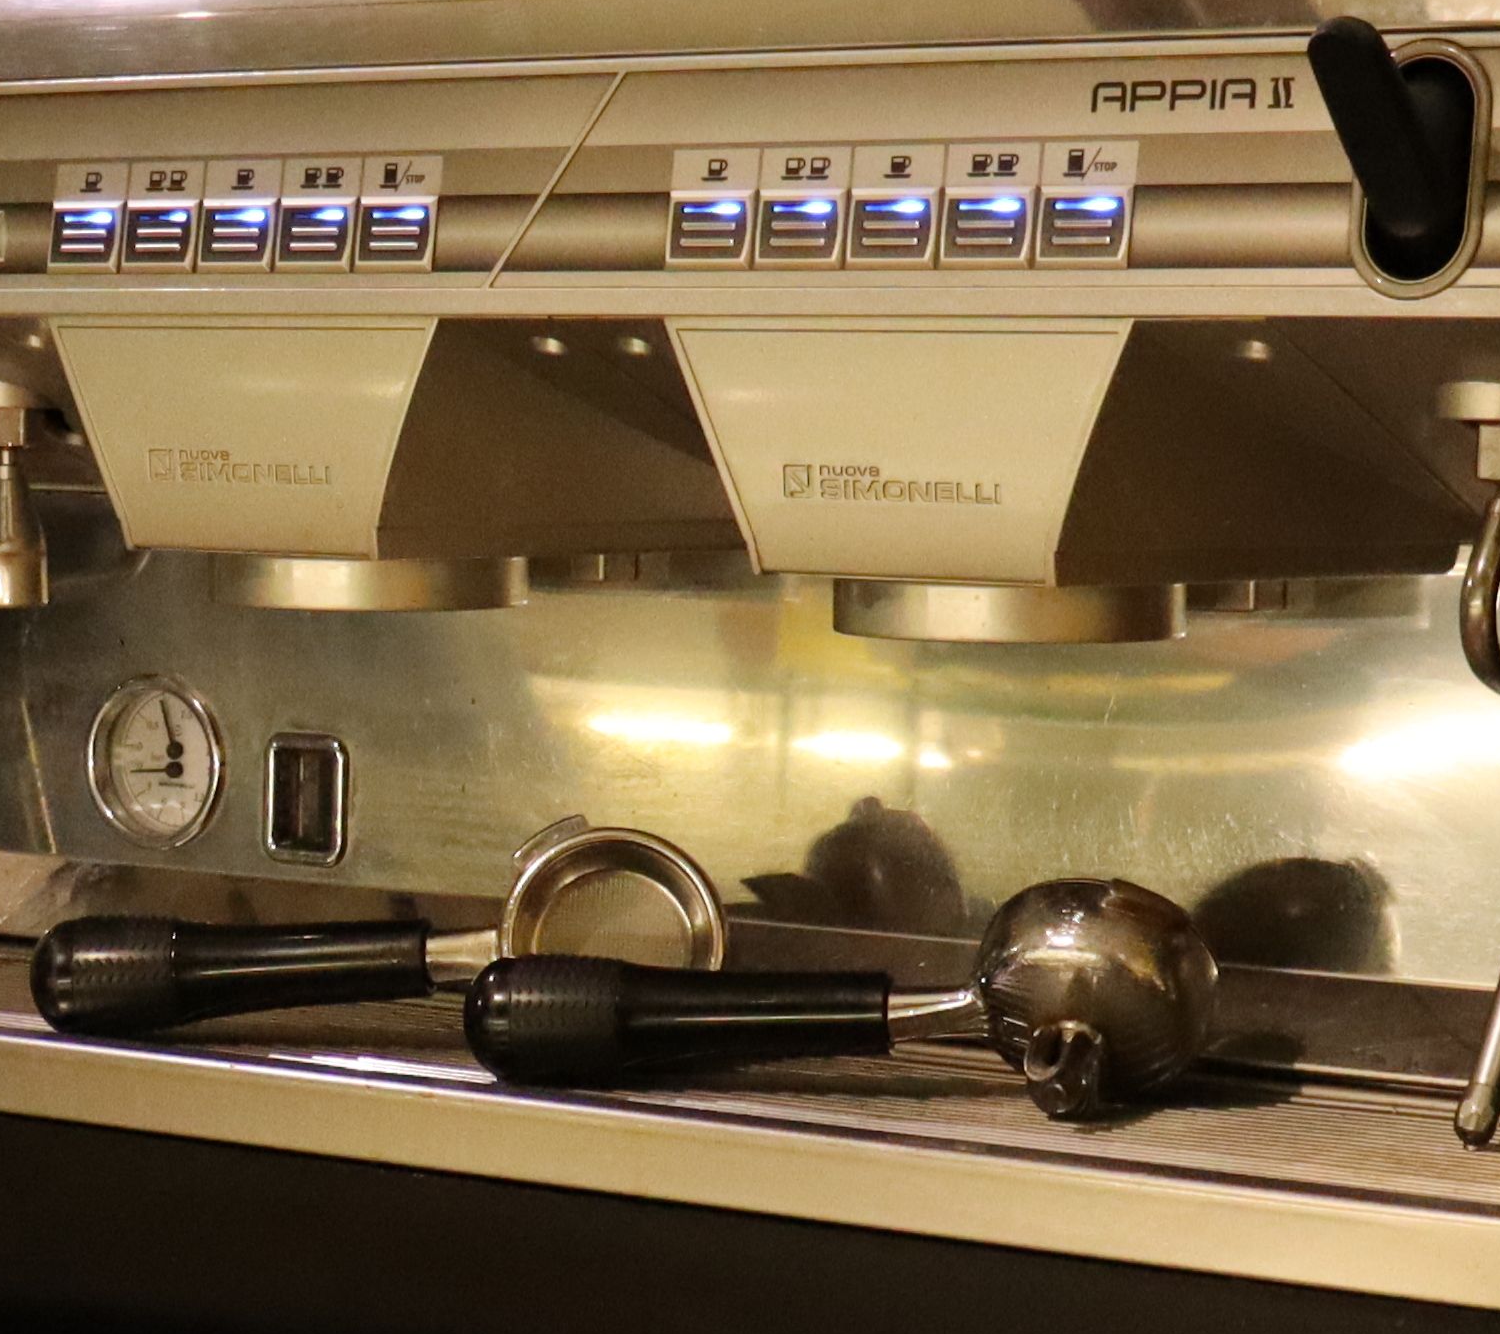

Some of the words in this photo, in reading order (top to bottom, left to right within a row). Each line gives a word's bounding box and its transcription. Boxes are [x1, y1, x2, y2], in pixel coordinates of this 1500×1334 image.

[1091, 77, 1257, 113] APPIA
[1267, 76, 1295, 109] II
[1094, 162, 1117, 172] STOP
[179, 449, 230, 461] nuova
[180, 461, 331, 485] SIMONELLI
[819, 464, 880, 477] nuova
[820, 478, 1003, 505] SIMONELLI
